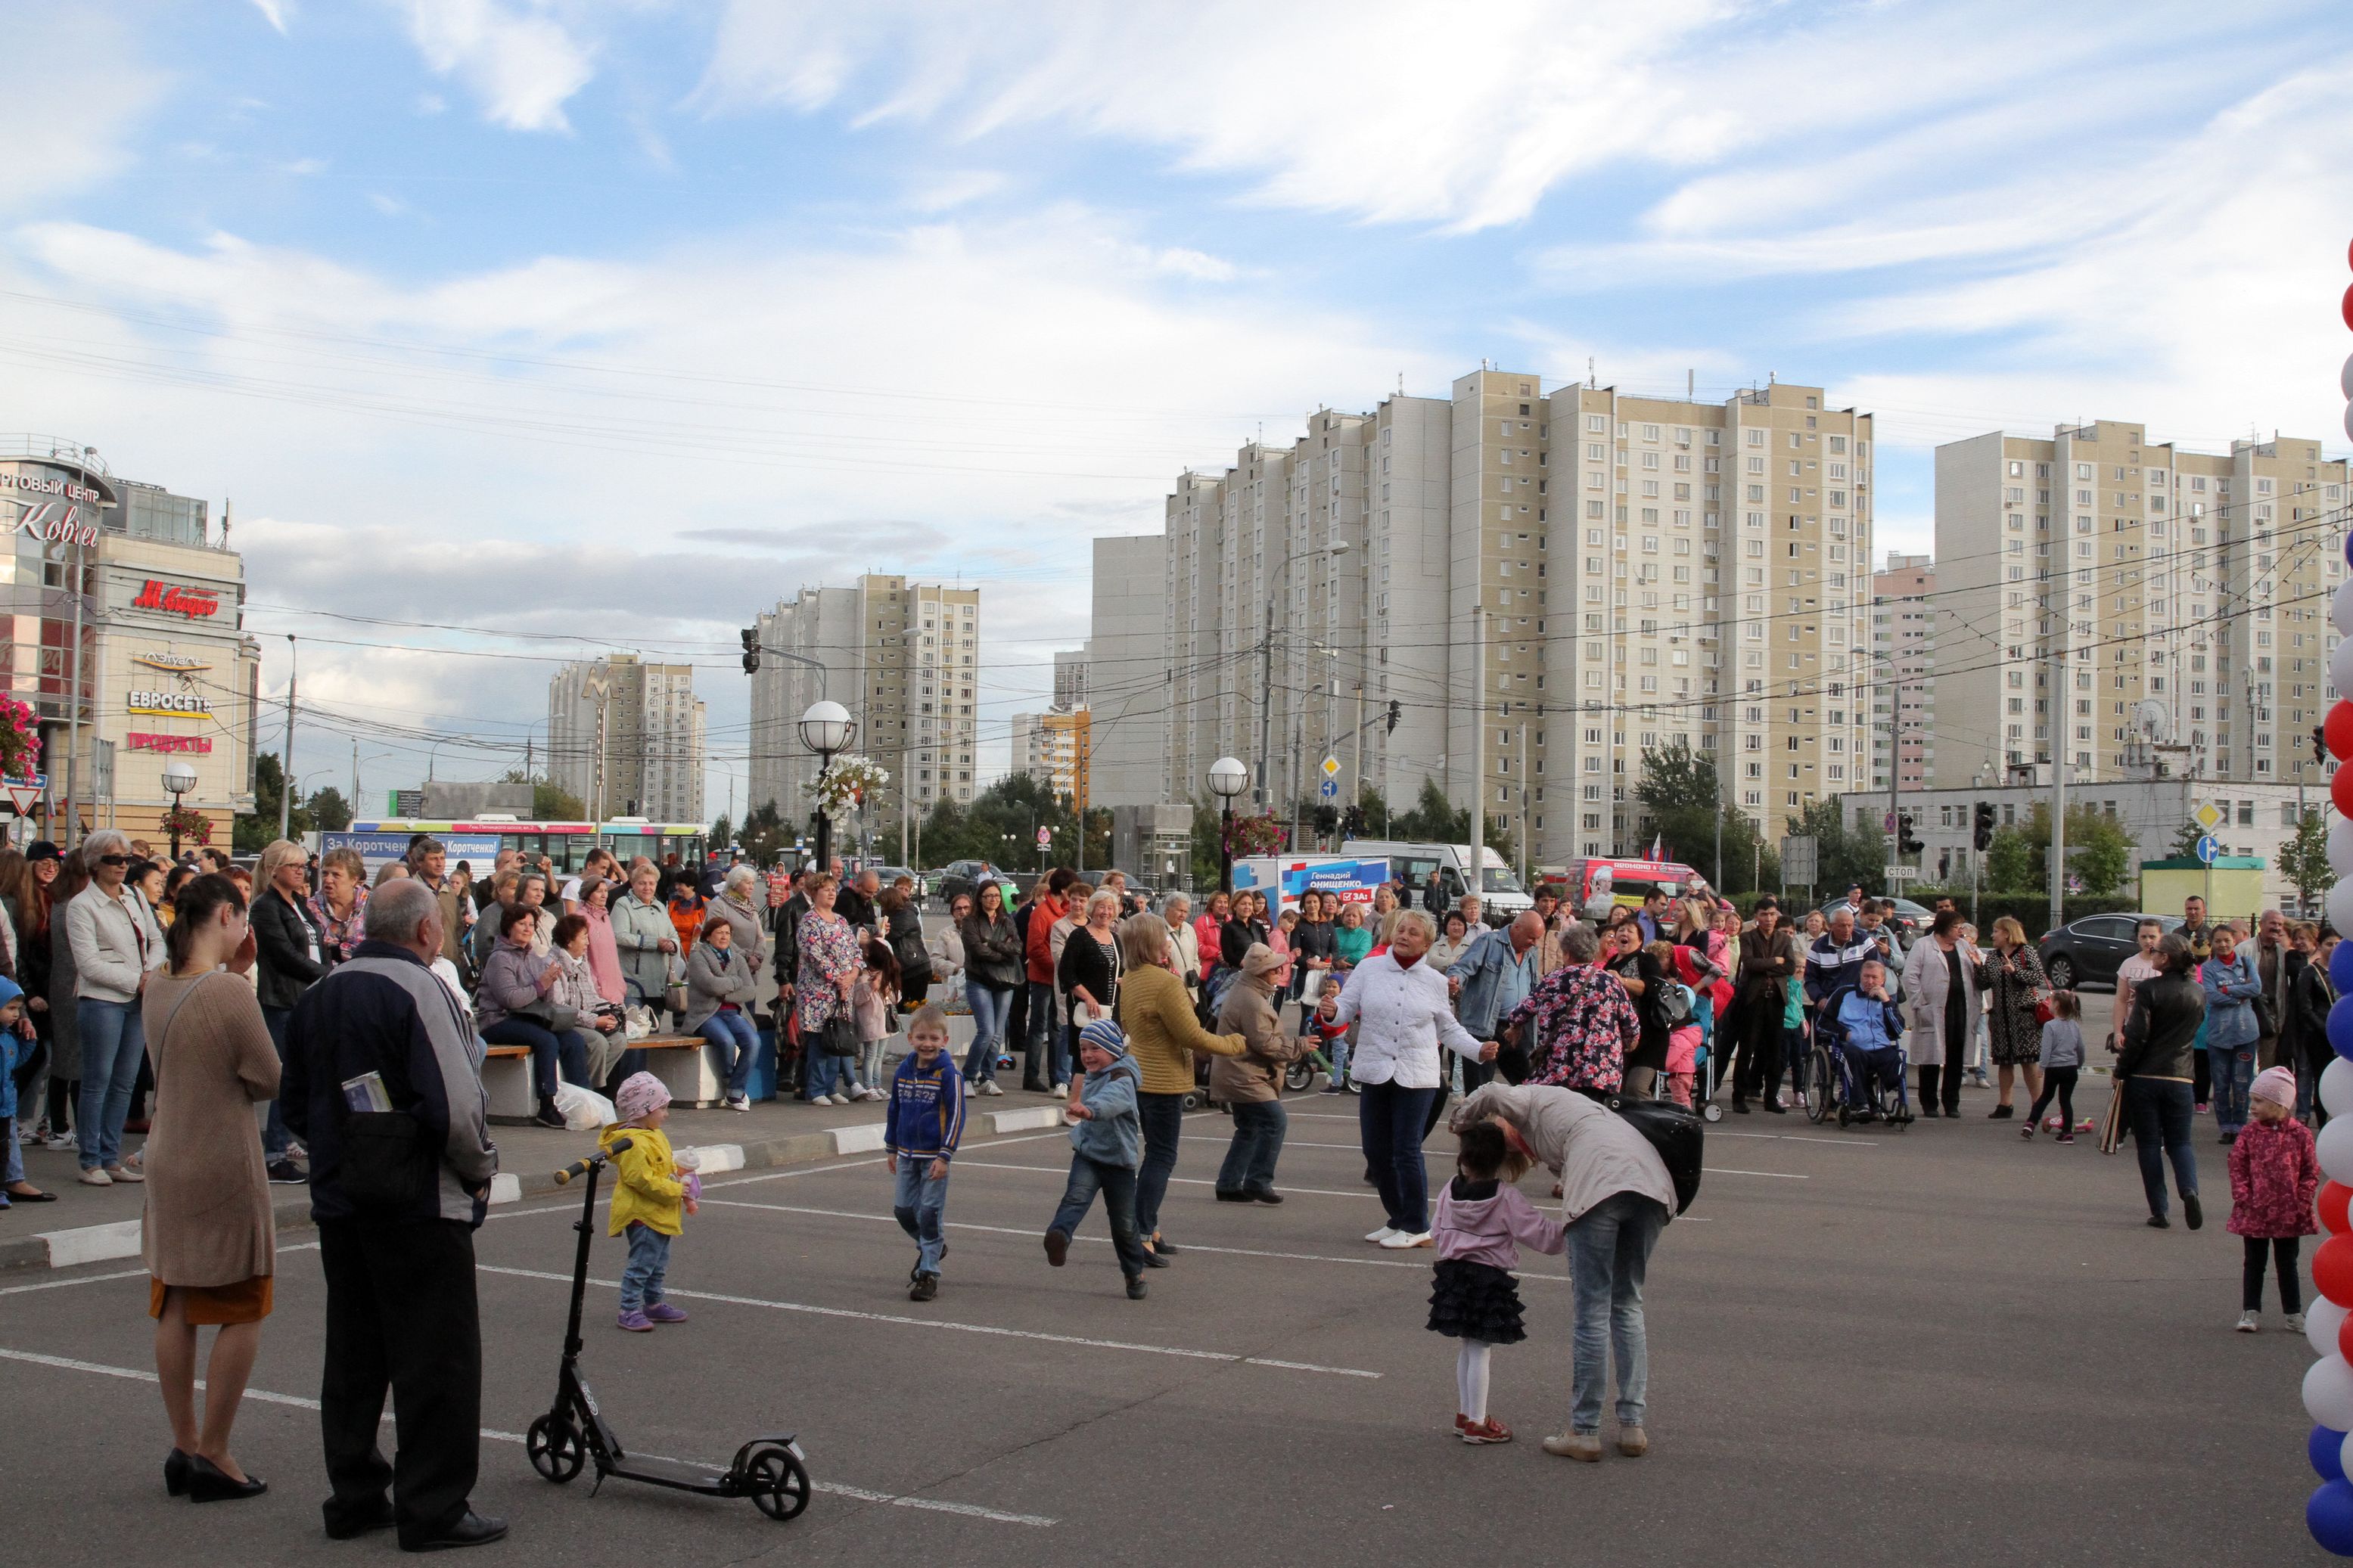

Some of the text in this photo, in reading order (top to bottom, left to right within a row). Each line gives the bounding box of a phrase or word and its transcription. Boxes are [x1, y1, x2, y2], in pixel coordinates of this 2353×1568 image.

[0, 474, 99, 502] РГОВЫЙ ЦЕНТР
[129, 690, 213, 712] ЕВРОСЕТЬ
[127, 732, 213, 753] ПРОДУКТЫ
[327, 838, 409, 852] За Коротчен
[447, 840, 496, 856] Коротченко!
[1614, 862, 1651, 871] REDMOND
[1888, 868, 1913, 876] СТОП
[1311, 871, 1351, 880] Геннадий
[1310, 880, 1362, 889] ОНИЩЕНКО
[1353, 893, 1368, 901] ЗА:
